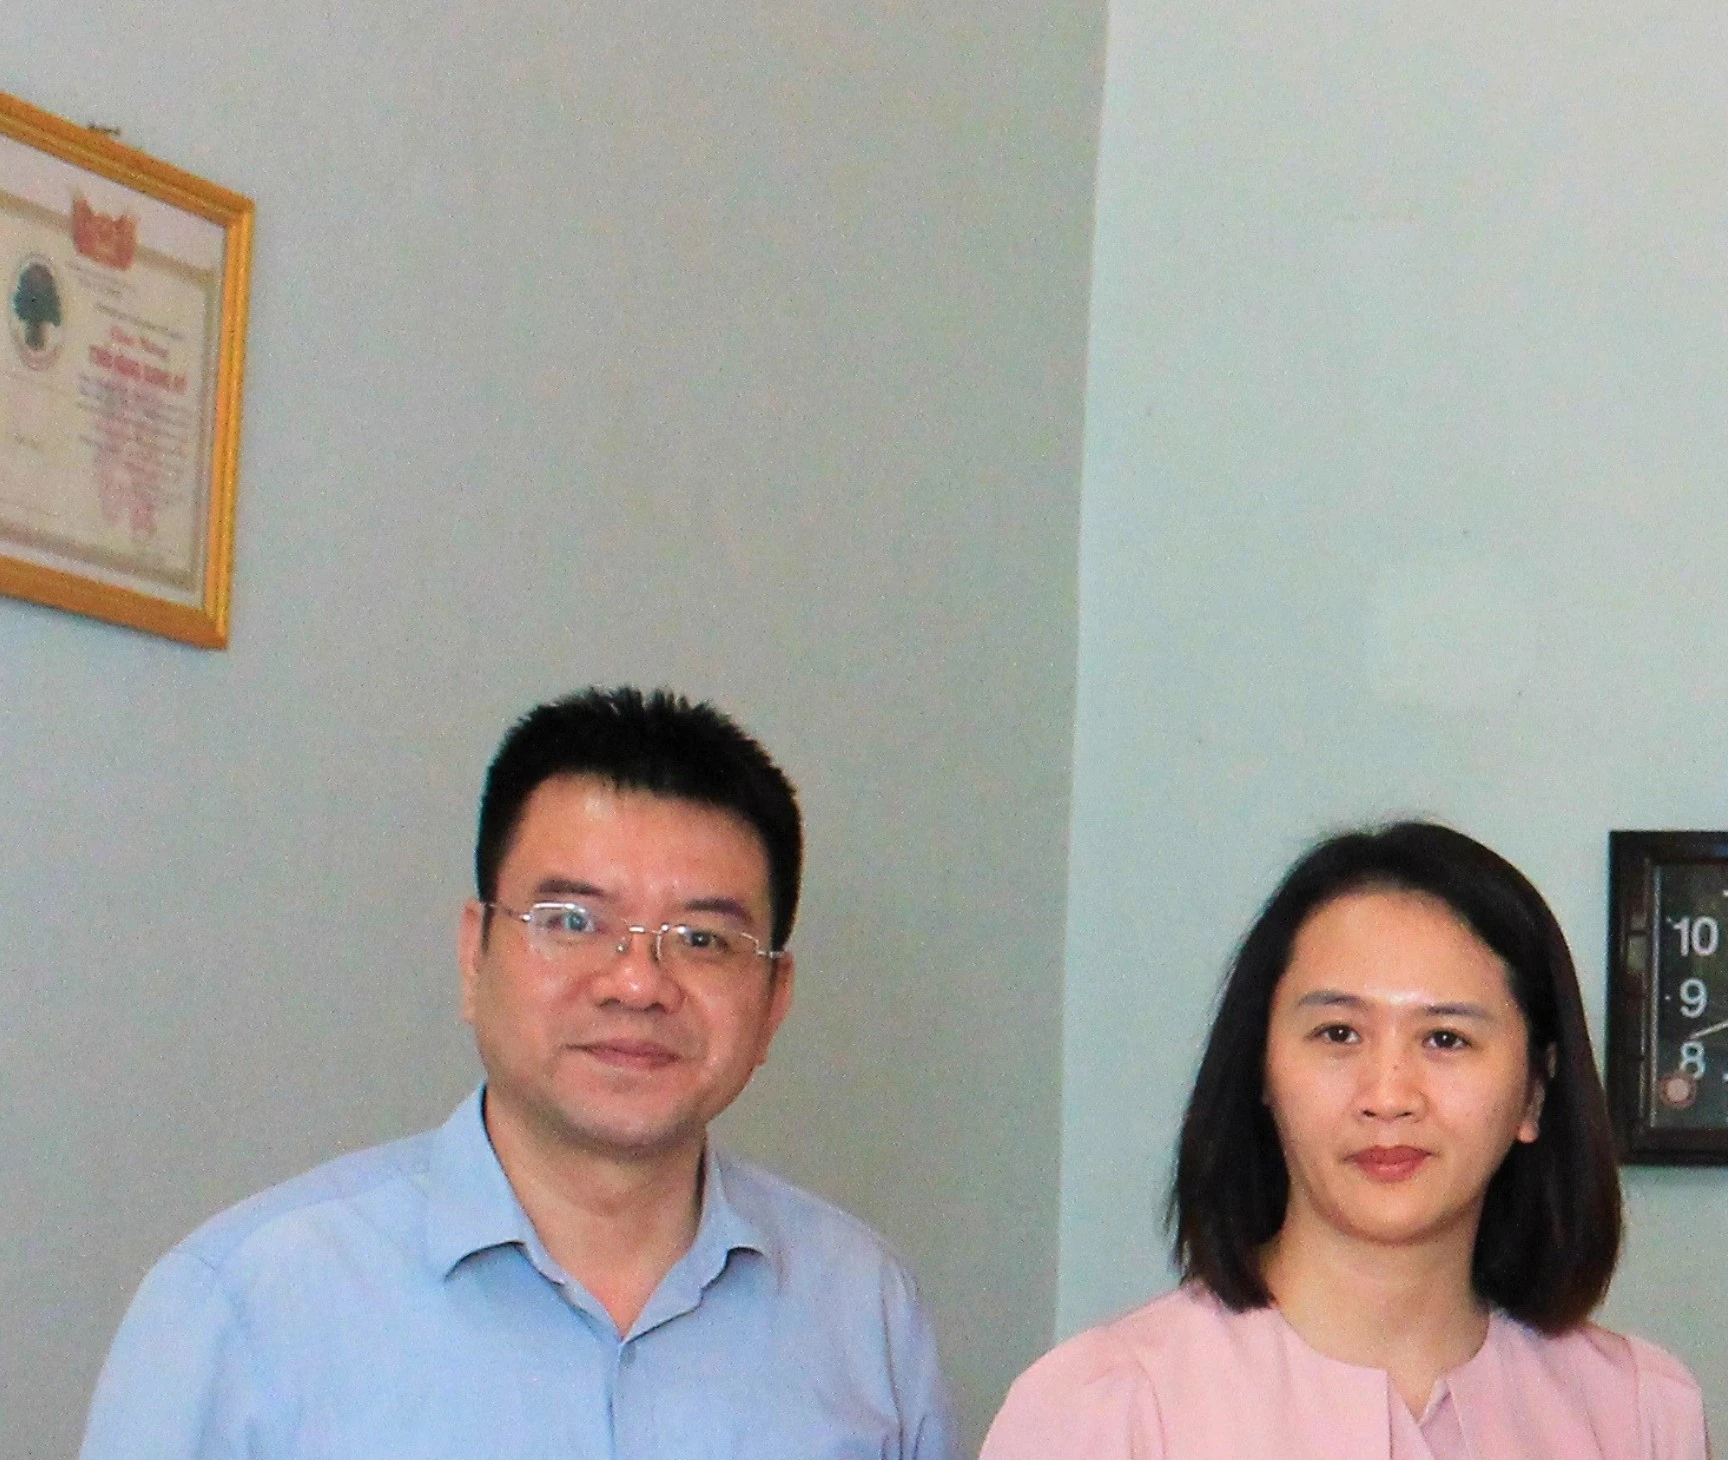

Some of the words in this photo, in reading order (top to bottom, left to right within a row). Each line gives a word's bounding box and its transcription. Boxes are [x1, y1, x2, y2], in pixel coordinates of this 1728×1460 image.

[1673, 916, 1720, 958] 10
[1679, 977, 1709, 1019] 9
[1679, 1040, 1706, 1081] 8
